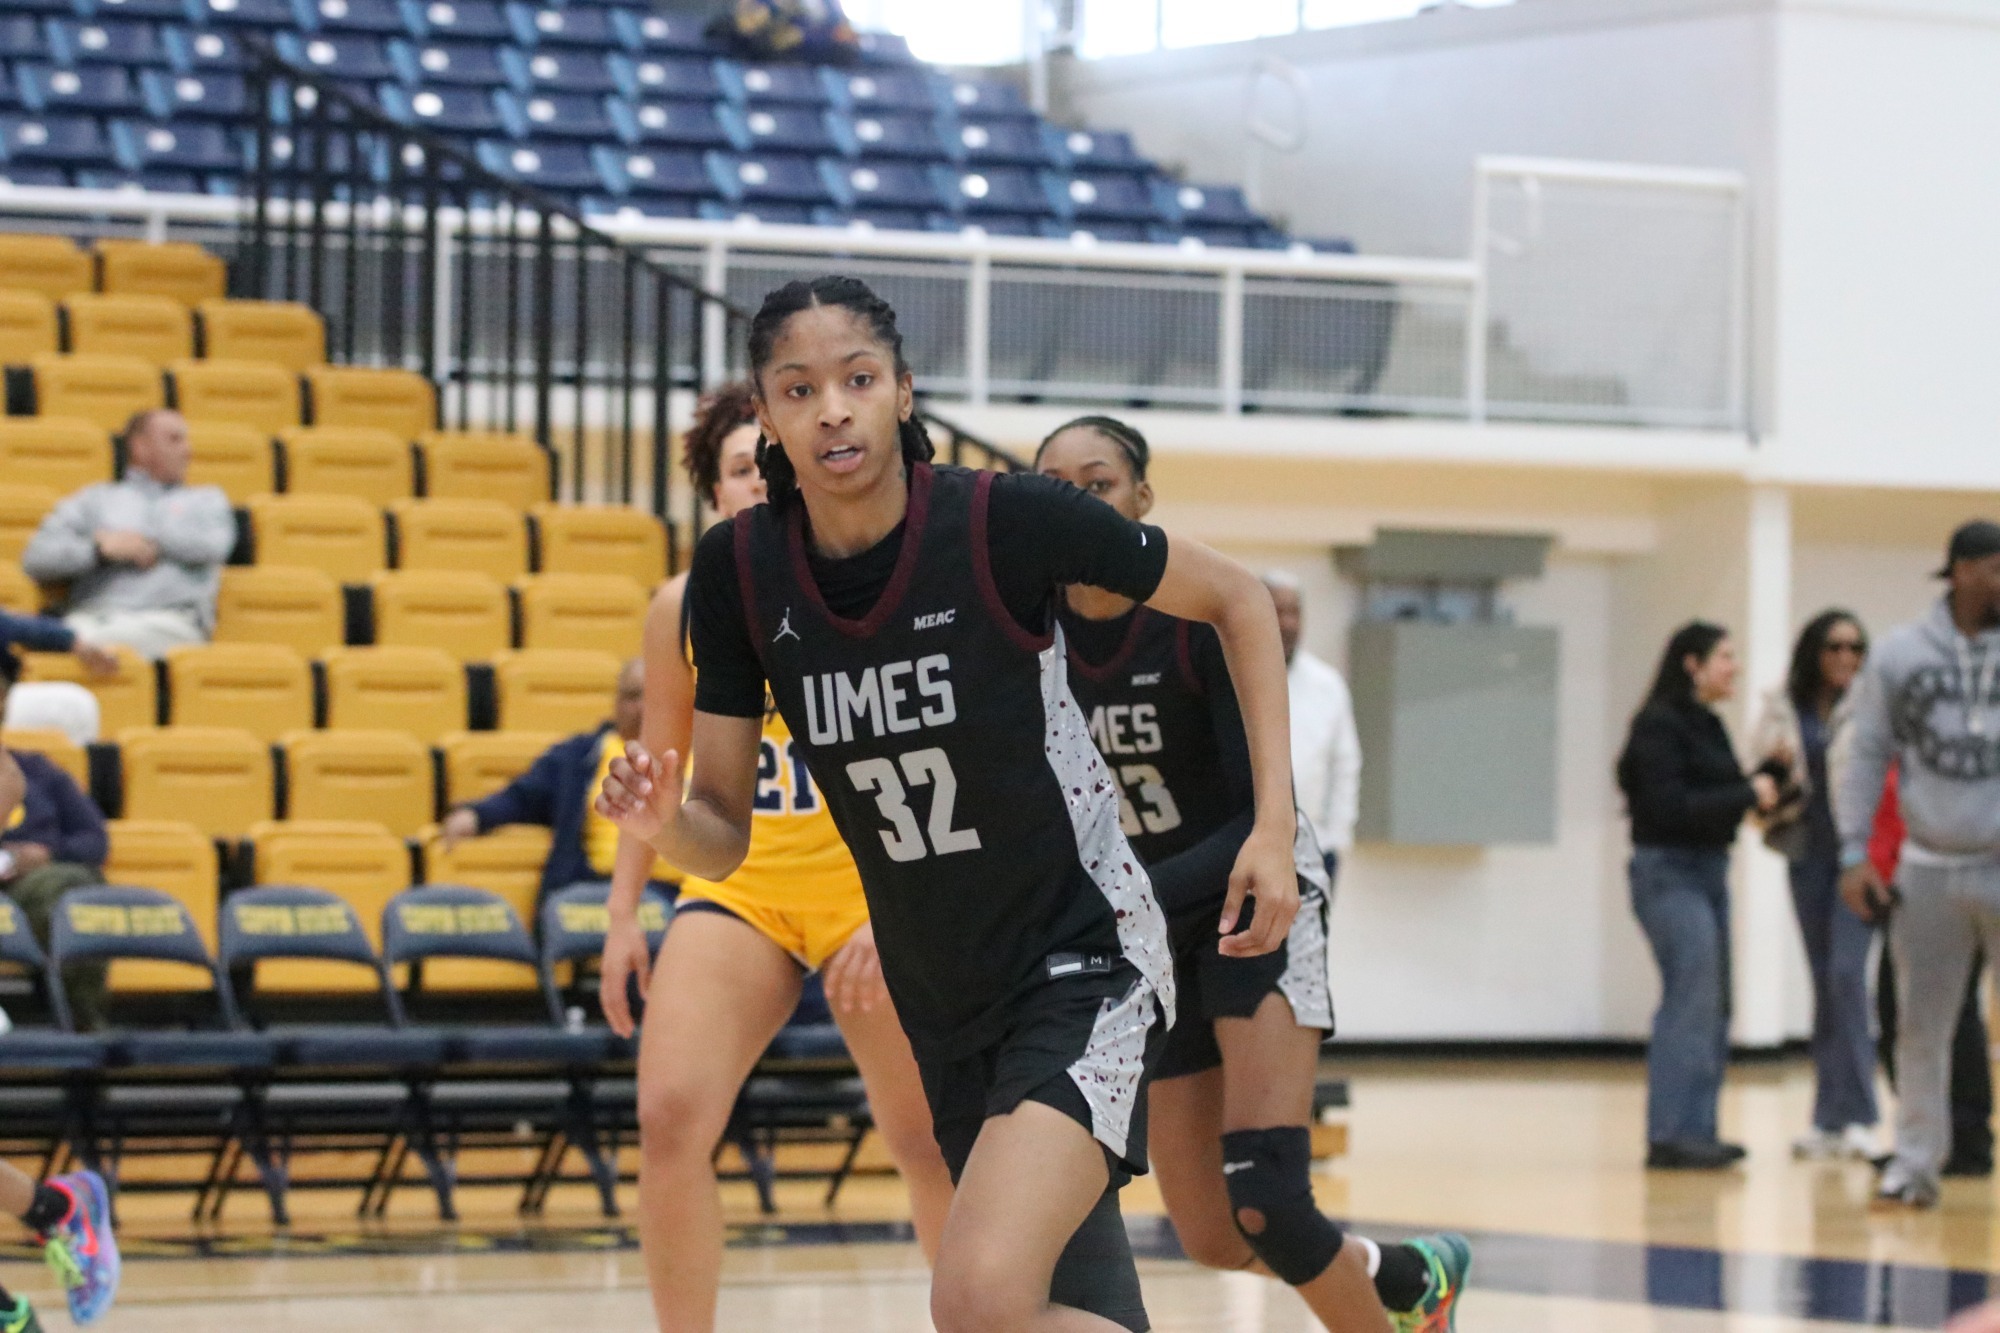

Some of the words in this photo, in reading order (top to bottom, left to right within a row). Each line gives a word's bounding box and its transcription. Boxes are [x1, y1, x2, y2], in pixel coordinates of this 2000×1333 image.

[913, 608, 956, 631] MEAC
[803, 652, 957, 747] UMES
[1088, 703, 1163, 755] MES
[845, 747, 982, 863] 32
[1090, 956, 1102, 965] M
